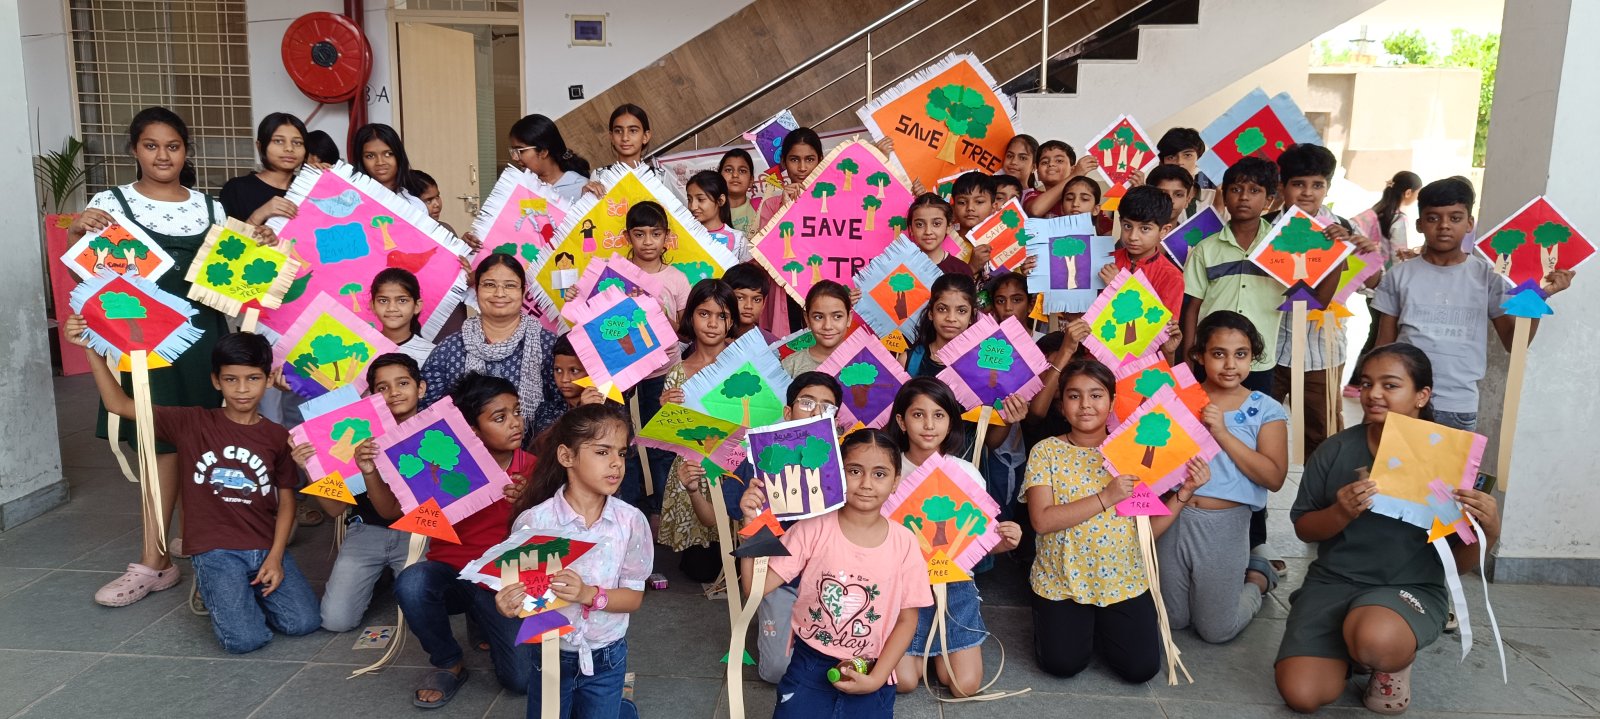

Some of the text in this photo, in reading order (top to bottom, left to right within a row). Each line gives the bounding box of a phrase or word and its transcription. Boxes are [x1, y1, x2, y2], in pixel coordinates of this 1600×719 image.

[895, 114, 1002, 174] SAVE TREE
[801, 216, 863, 240] SAVE
[985, 223, 1006, 239] SAVE
[828, 256, 871, 279] TR
[1548, 256, 1557, 270] SAV
[240, 287, 261, 298] TREE
[605, 328, 621, 337] TREE
[886, 339, 899, 347] TREE
[986, 344, 1005, 354] SAVE
[984, 354, 1004, 365] TREE
[661, 408, 690, 418] SAVE
[656, 417, 694, 426] TREE
[730, 449, 746, 458] SAVE
[193, 450, 218, 485] CAR
[727, 458, 740, 467] TRE
[323, 476, 345, 489] SAVE
[318, 485, 344, 498] TREE
[1130, 501, 1150, 509] TREE
[418, 506, 440, 518] SAVE
[415, 516, 437, 528] TREE
[931, 558, 948, 566] SAVE
[928, 569, 948, 577] TREE
[527, 584, 549, 596] TRE
